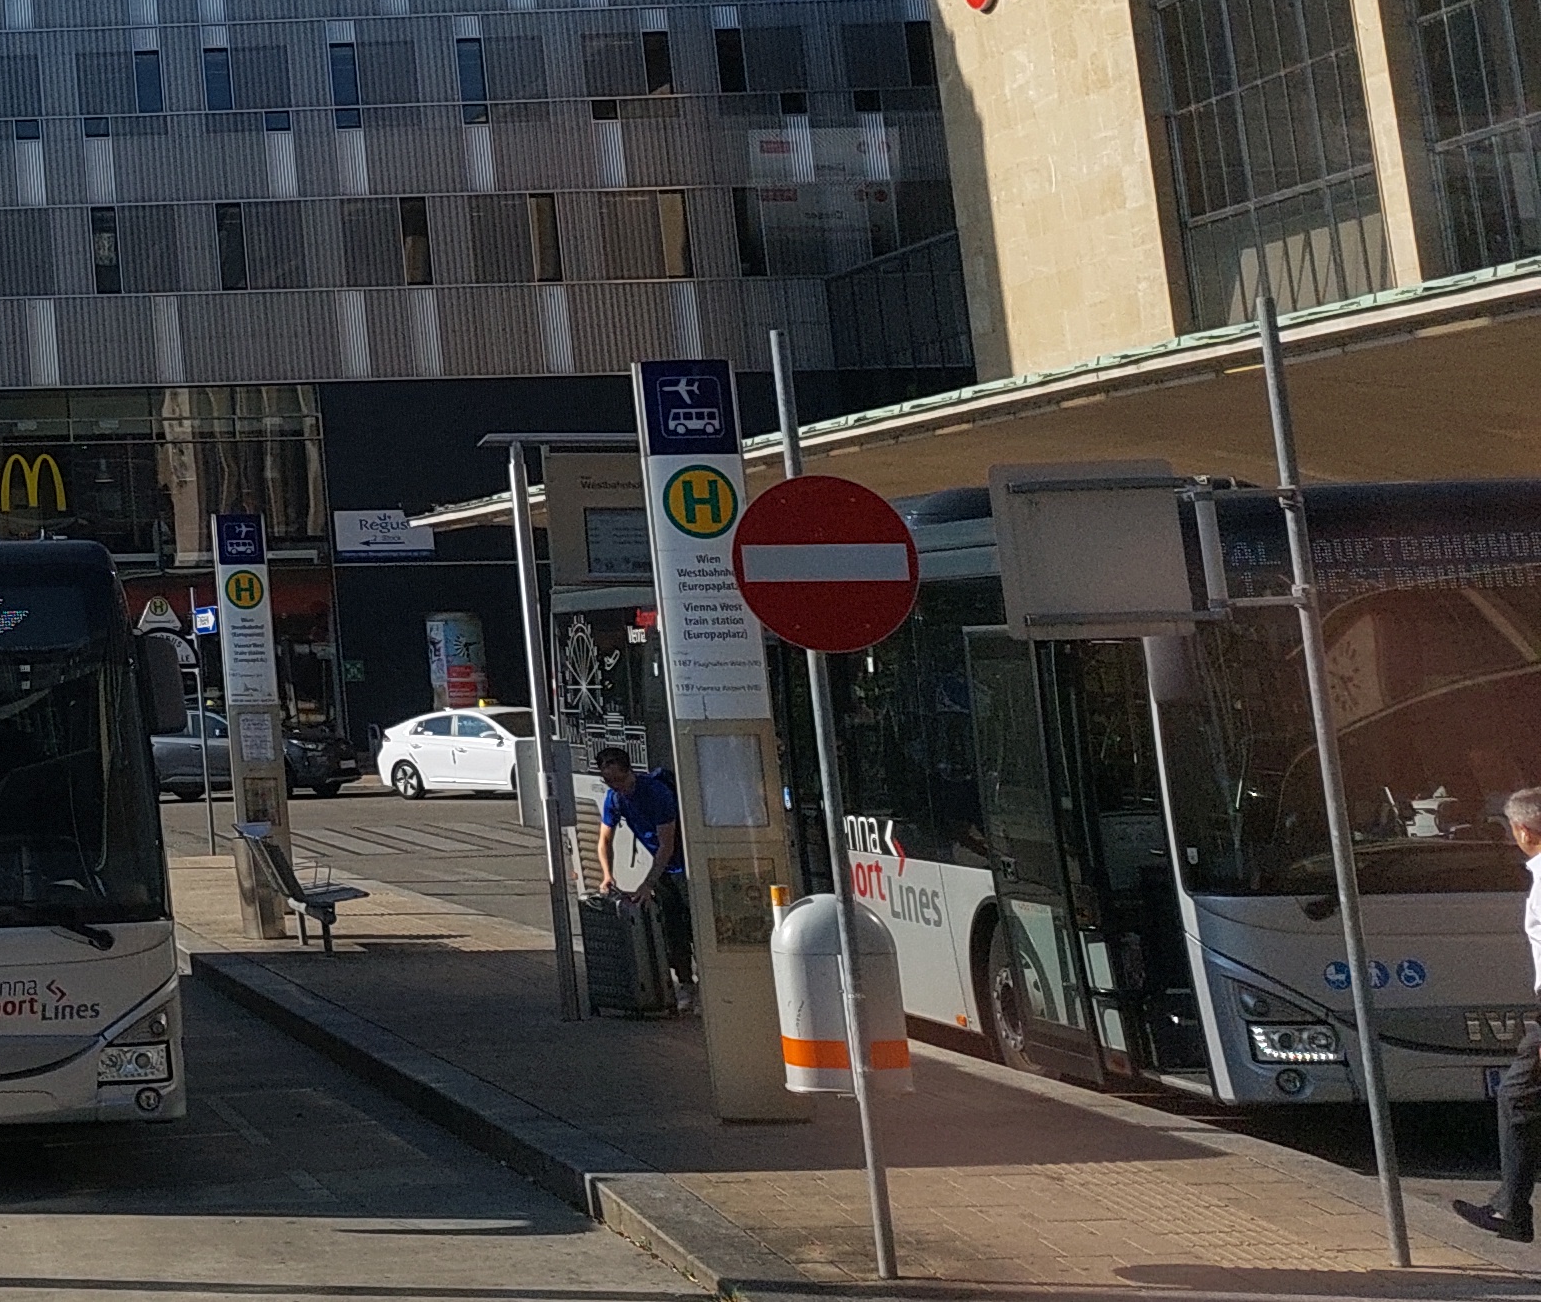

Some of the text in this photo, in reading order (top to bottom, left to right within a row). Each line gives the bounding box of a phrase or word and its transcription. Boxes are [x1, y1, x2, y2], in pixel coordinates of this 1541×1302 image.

[682, 480, 721, 524] H
[359, 518, 408, 533] Regus
[696, 554, 721, 564] Wien
[677, 568, 735, 578] Westbahnh
[683, 602, 743, 612] Vienna West
[684, 616, 744, 626] train station
[683, 629, 748, 641] (Europaplatz)
[886, 875, 942, 928] Lines
[40, 1002, 100, 1021] Lines
